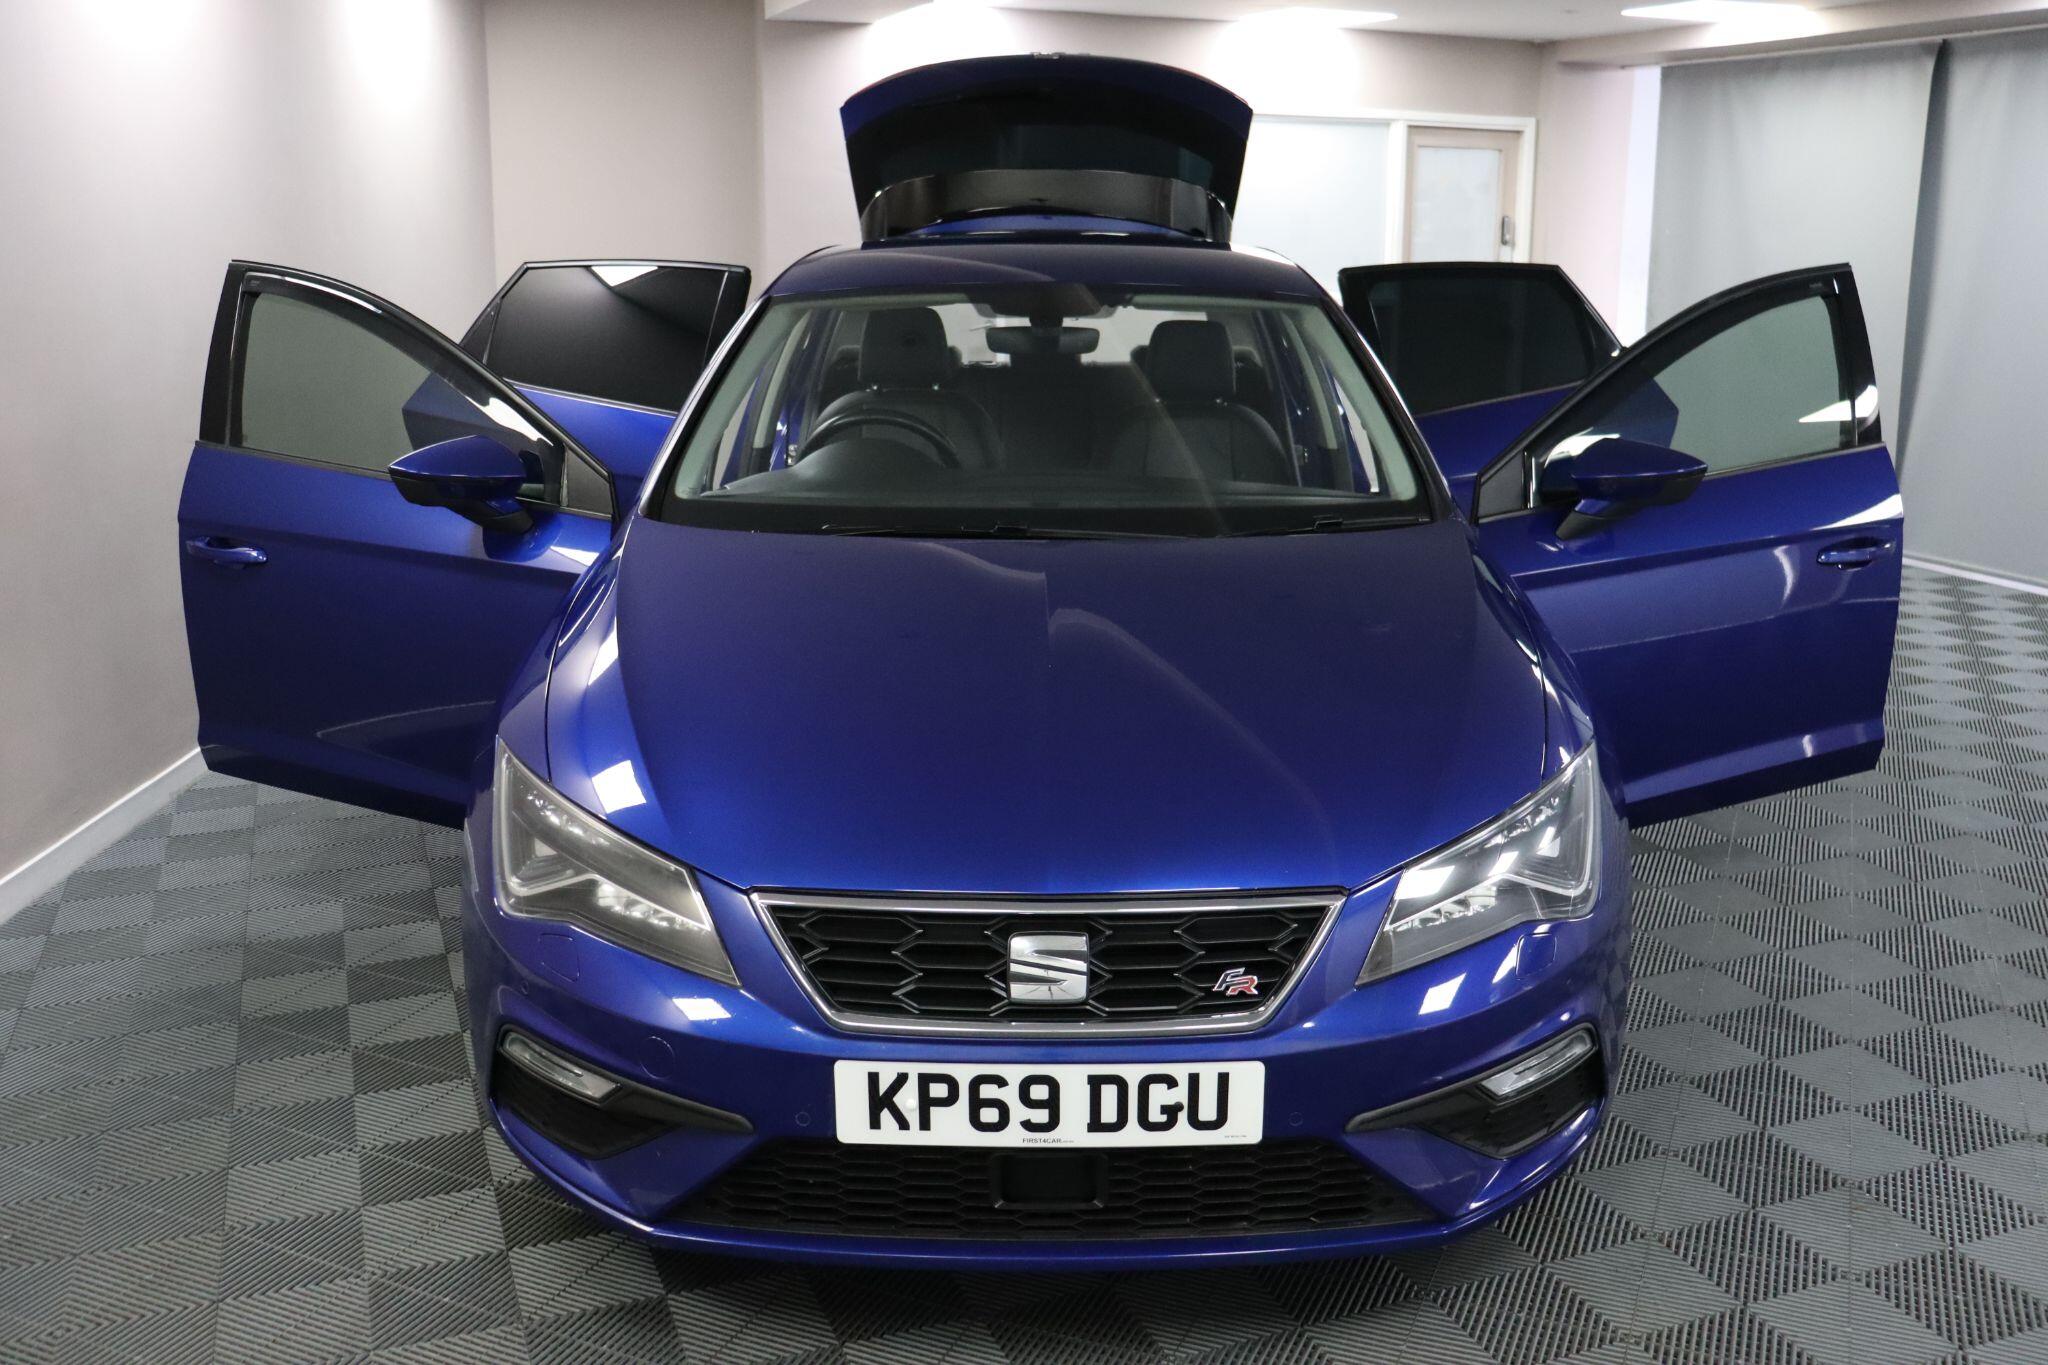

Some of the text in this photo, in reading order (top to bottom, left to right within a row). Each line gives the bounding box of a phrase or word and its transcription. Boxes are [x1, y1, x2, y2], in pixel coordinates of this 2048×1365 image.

[1212, 967, 1259, 997] FR
[867, 1071, 1230, 1133] KP69 DGU
